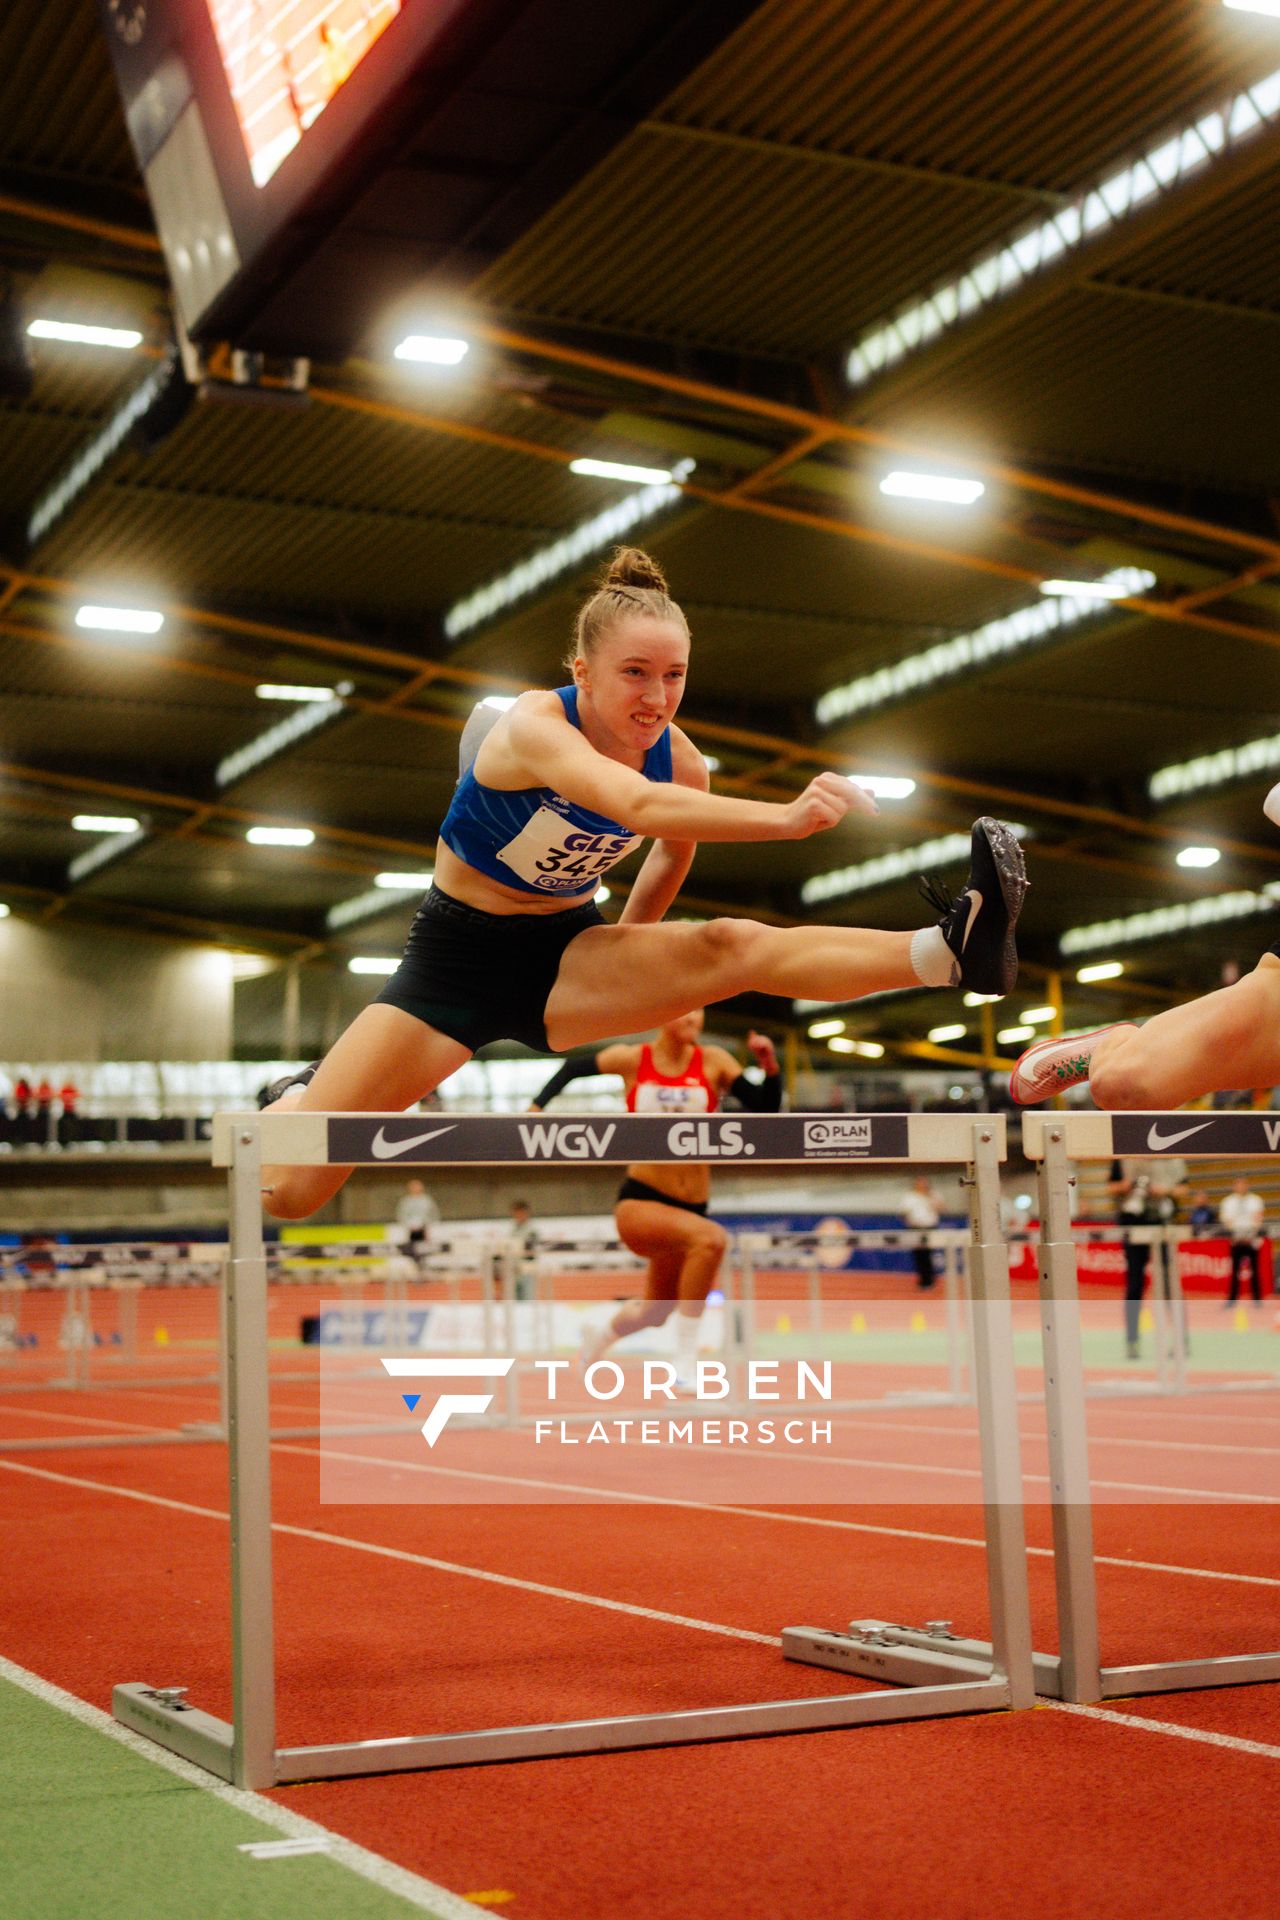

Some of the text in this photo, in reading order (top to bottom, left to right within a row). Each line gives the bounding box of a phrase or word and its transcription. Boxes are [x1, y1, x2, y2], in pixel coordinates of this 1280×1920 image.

[563, 833, 631, 854] GLS
[535, 847, 619, 877] 345
[518, 1122, 617, 1159] WGV
[667, 1121, 756, 1157] GLS.
[832, 1125, 868, 1137] PLAN
